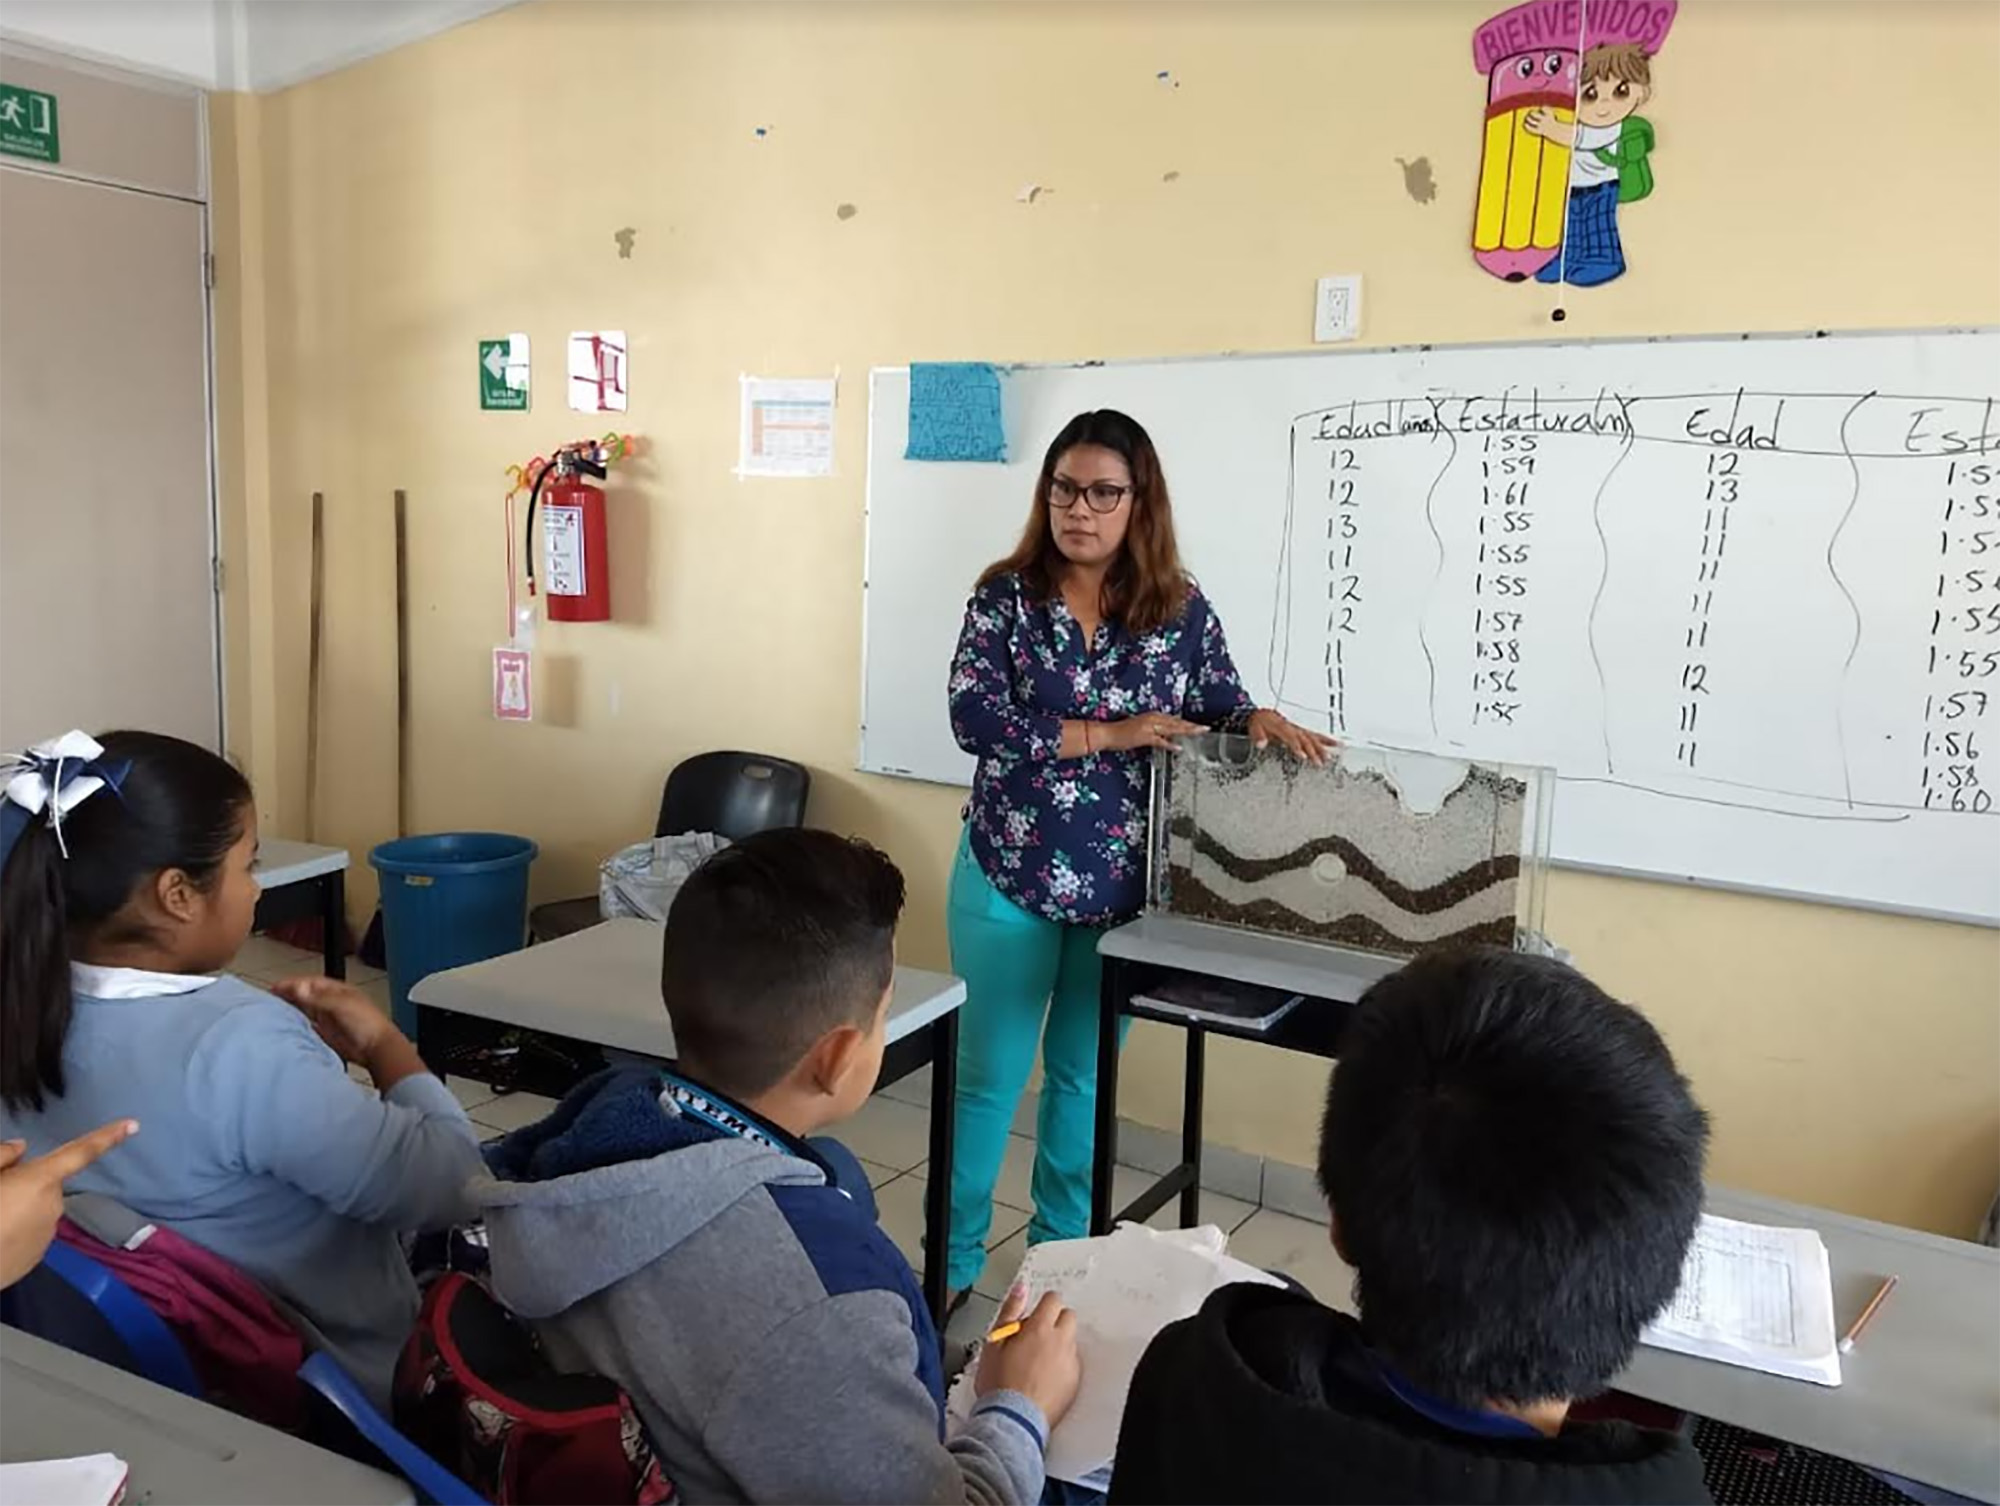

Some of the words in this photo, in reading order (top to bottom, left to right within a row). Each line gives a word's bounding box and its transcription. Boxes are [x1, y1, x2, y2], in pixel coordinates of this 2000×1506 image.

[1480, 0, 1668, 61] BIENVENIDOS
[1686, 388, 1783, 450] Edad
[1905, 397, 2000, 455] Est
[1484, 434, 1538, 453] 1.55
[1331, 449, 1361, 470] 12
[1482, 455, 1535, 478] 1.59
[1707, 452, 1740, 476] 12
[1947, 462, 2000, 486] 1.5
[1329, 479, 1359, 507] 12
[1483, 481, 1528, 506] 1.61
[1706, 478, 1738, 503] 13
[1945, 495, 2000, 522] 1.5
[1328, 515, 1357, 539] 13
[1479, 511, 1533, 535] 1.55
[1479, 543, 1530, 564] 1.55
[1941, 531, 2000, 555] 1.5
[1329, 575, 1362, 602] 12
[1476, 573, 1527, 596] 1.55
[1328, 607, 1356, 634] 12
[1475, 609, 1523, 633] 1.57
[1477, 639, 1520, 663] 1.58
[1473, 669, 1518, 692] 1.56
[1683, 664, 1709, 695] 12
[1925, 691, 1987, 722] 1.57
[1924, 731, 1979, 760] 1.56
